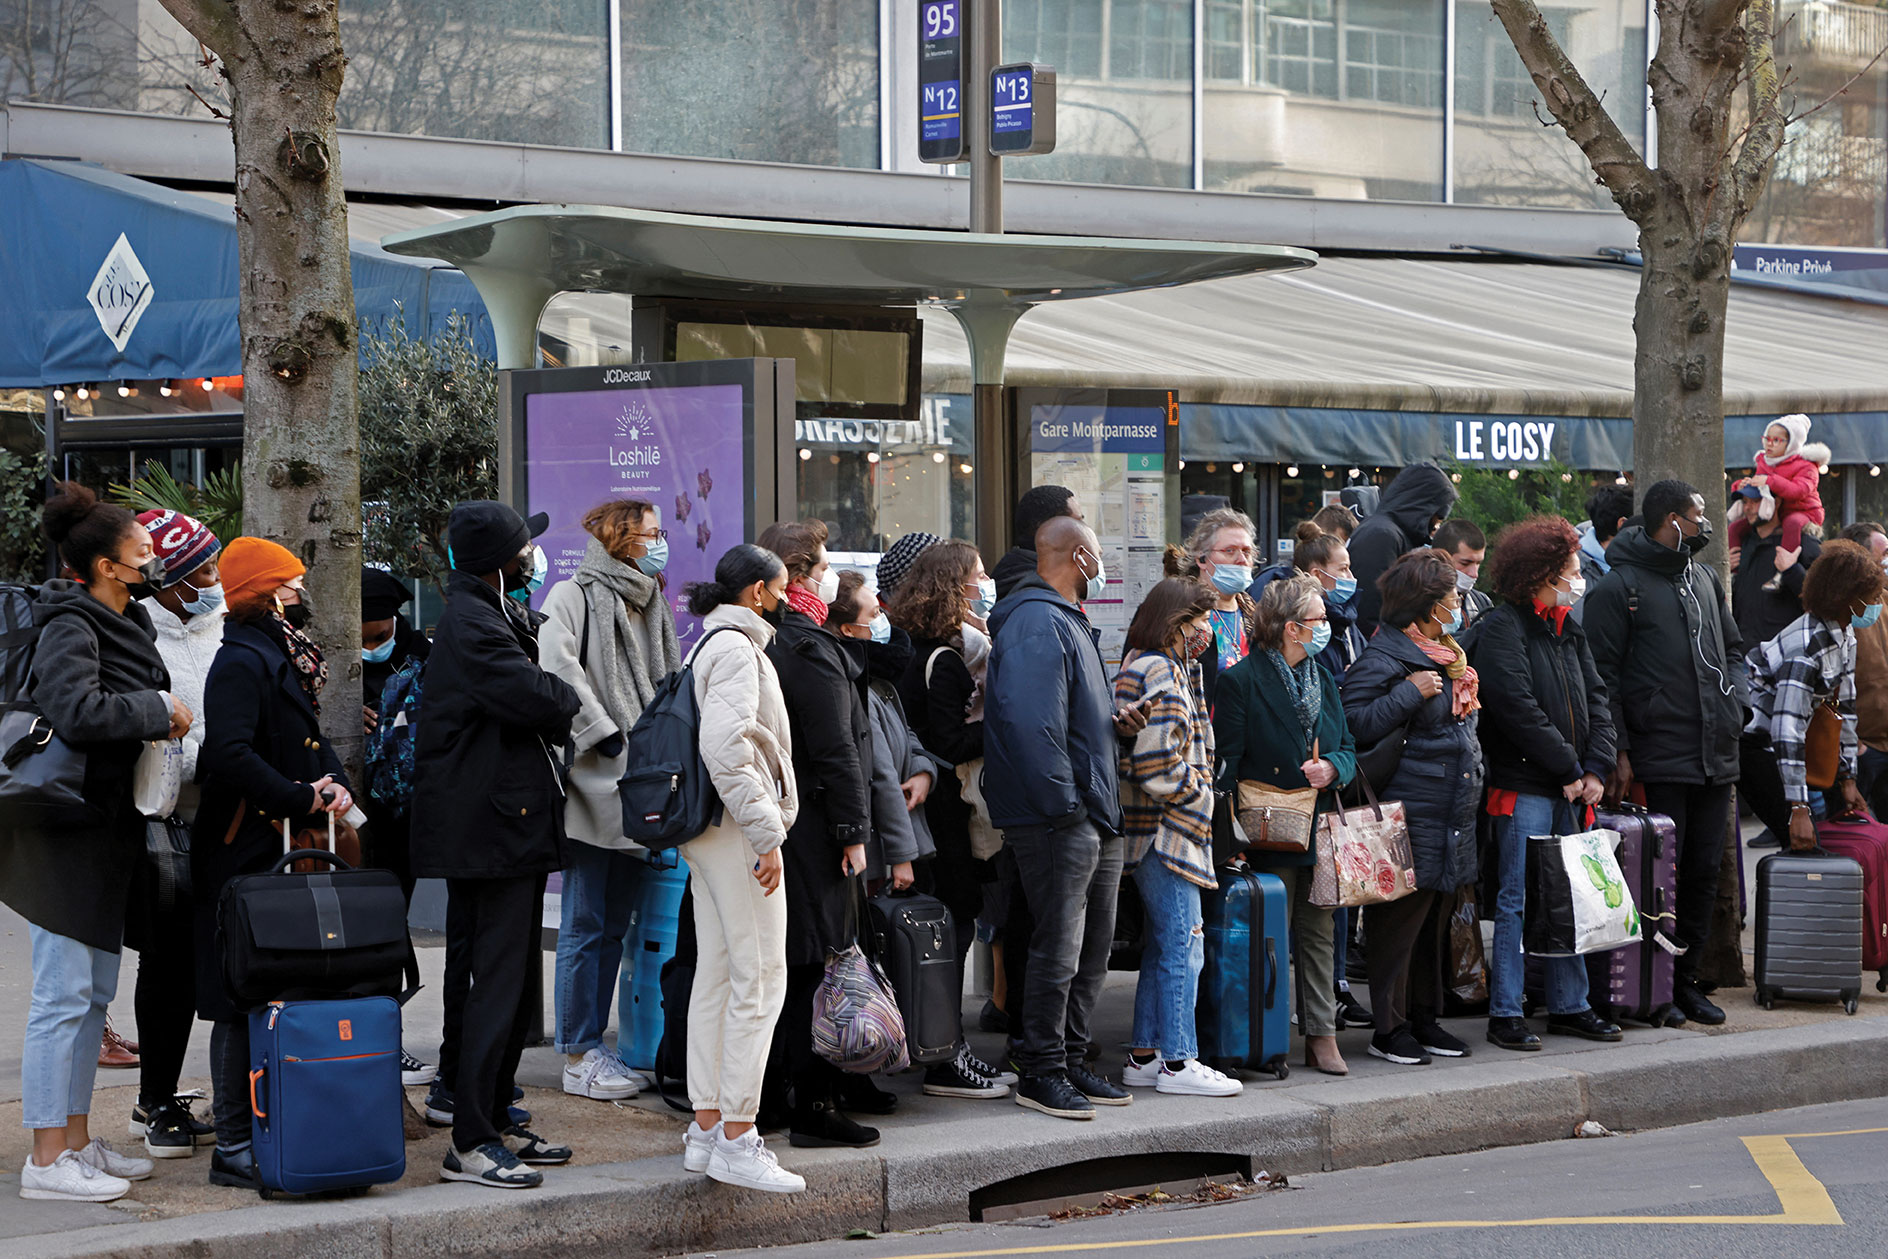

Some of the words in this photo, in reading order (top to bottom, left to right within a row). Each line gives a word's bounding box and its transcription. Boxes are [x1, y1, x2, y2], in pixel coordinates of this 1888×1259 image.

[927, 4, 955, 37] 95
[996, 76, 1029, 101] N13
[925, 87, 957, 111] N12
[1756, 257, 1800, 275] Parking
[603, 369, 652, 384] JCDecaux
[1040, 421, 1069, 438] Gare
[1072, 421, 1157, 441] Montparnasse
[1455, 421, 1484, 460] LE
[1491, 421, 1555, 461] COSY
[621, 471, 650, 479] BEAUTY
[562, 549, 585, 557] FORMULE
